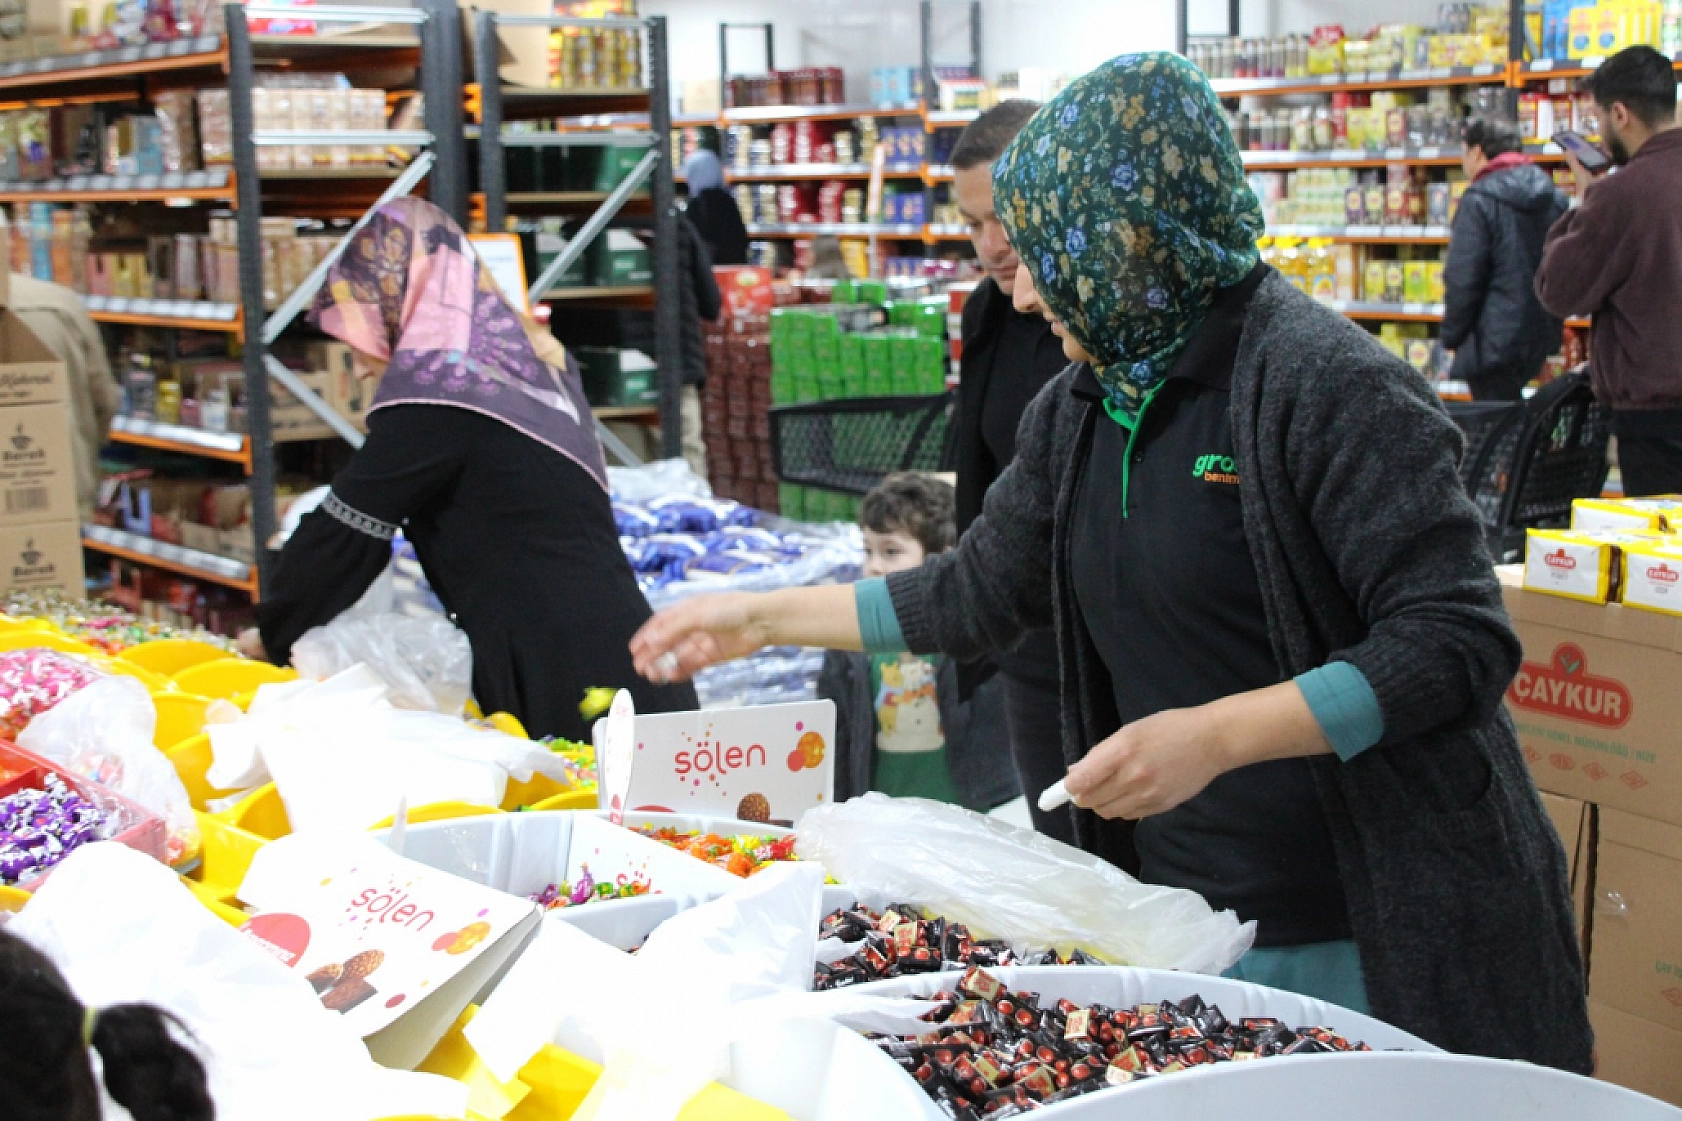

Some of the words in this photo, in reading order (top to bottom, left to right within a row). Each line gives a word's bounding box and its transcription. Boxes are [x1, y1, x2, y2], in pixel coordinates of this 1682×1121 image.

[1192, 454, 1235, 477] gro
[1513, 671, 1623, 719] ÇAYKUR
[674, 740, 766, 782] şölen
[345, 887, 436, 933] şölen
